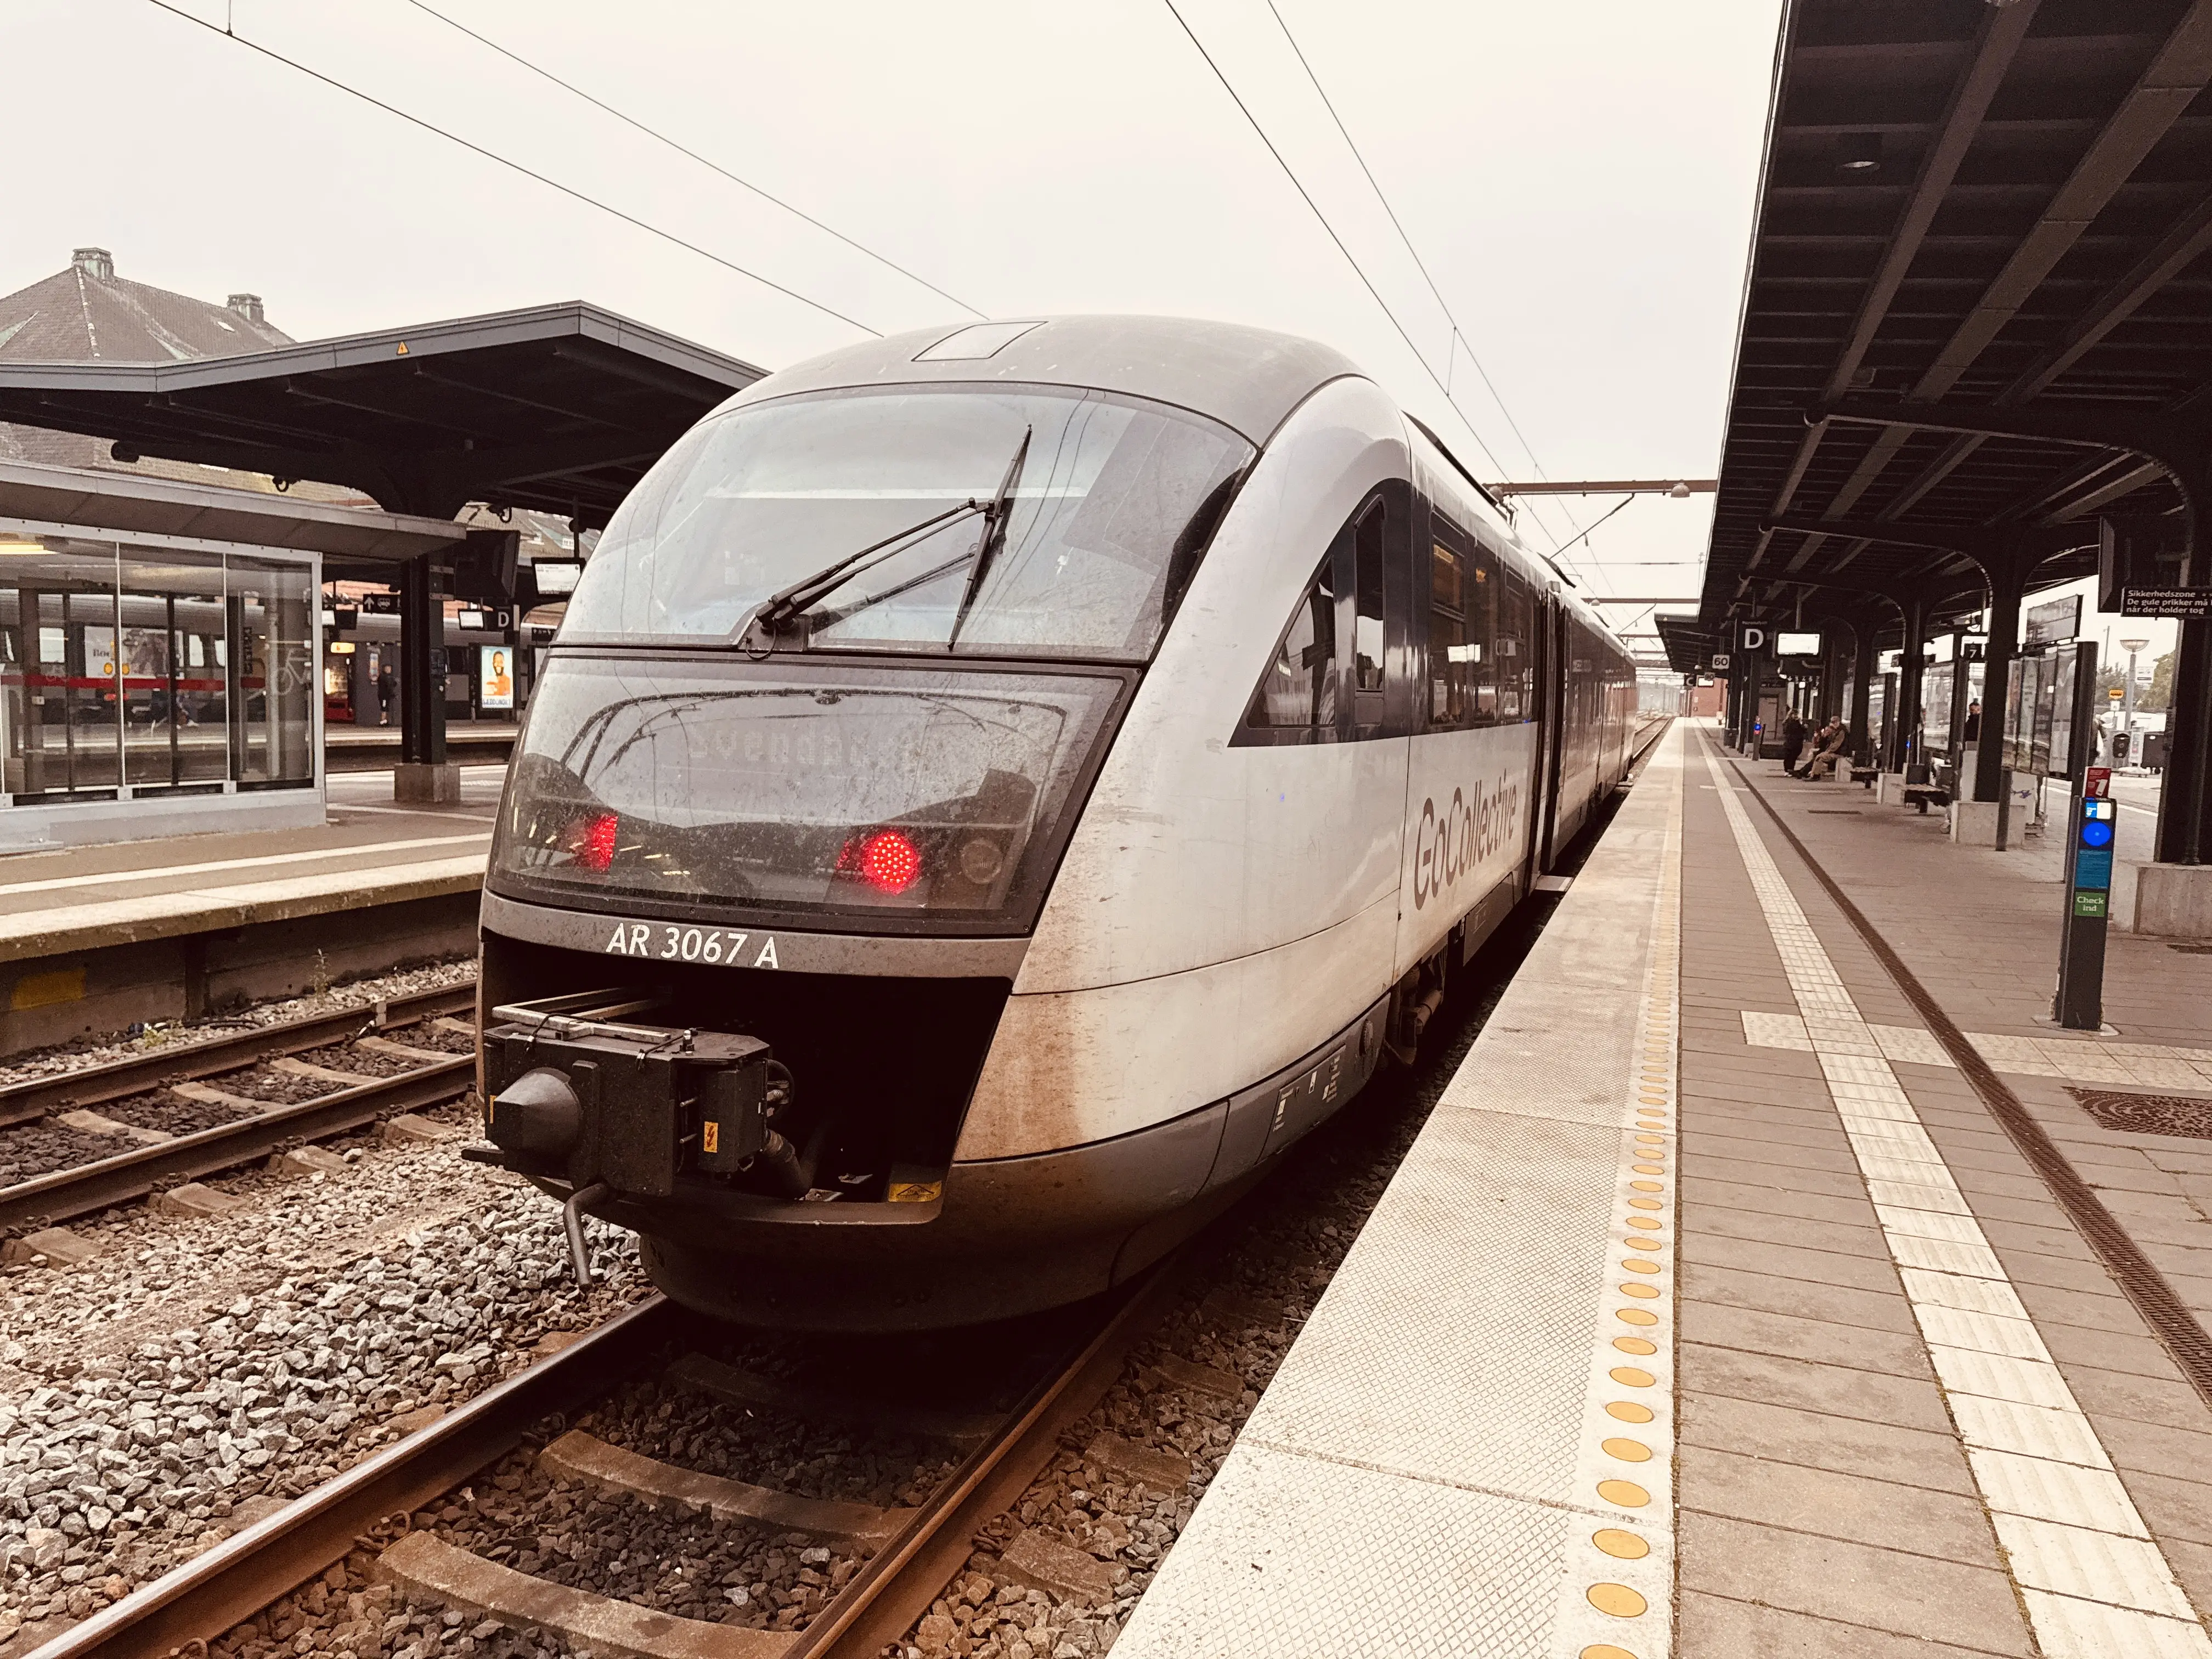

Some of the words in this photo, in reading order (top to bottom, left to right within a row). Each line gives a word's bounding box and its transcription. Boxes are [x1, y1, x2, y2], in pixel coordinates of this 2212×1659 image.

[498, 612, 509, 627] D
[1744, 628, 1764, 649] D
[1970, 649, 1977, 658] 7
[1714, 657, 1728, 666] 60
[1686, 677, 1695, 686] C
[1414, 768, 1516, 911] GoCollective
[2077, 896, 2104, 904] Check
[605, 922, 650, 956] AR
[660, 927, 748, 964] 3067
[753, 936, 778, 969] A
